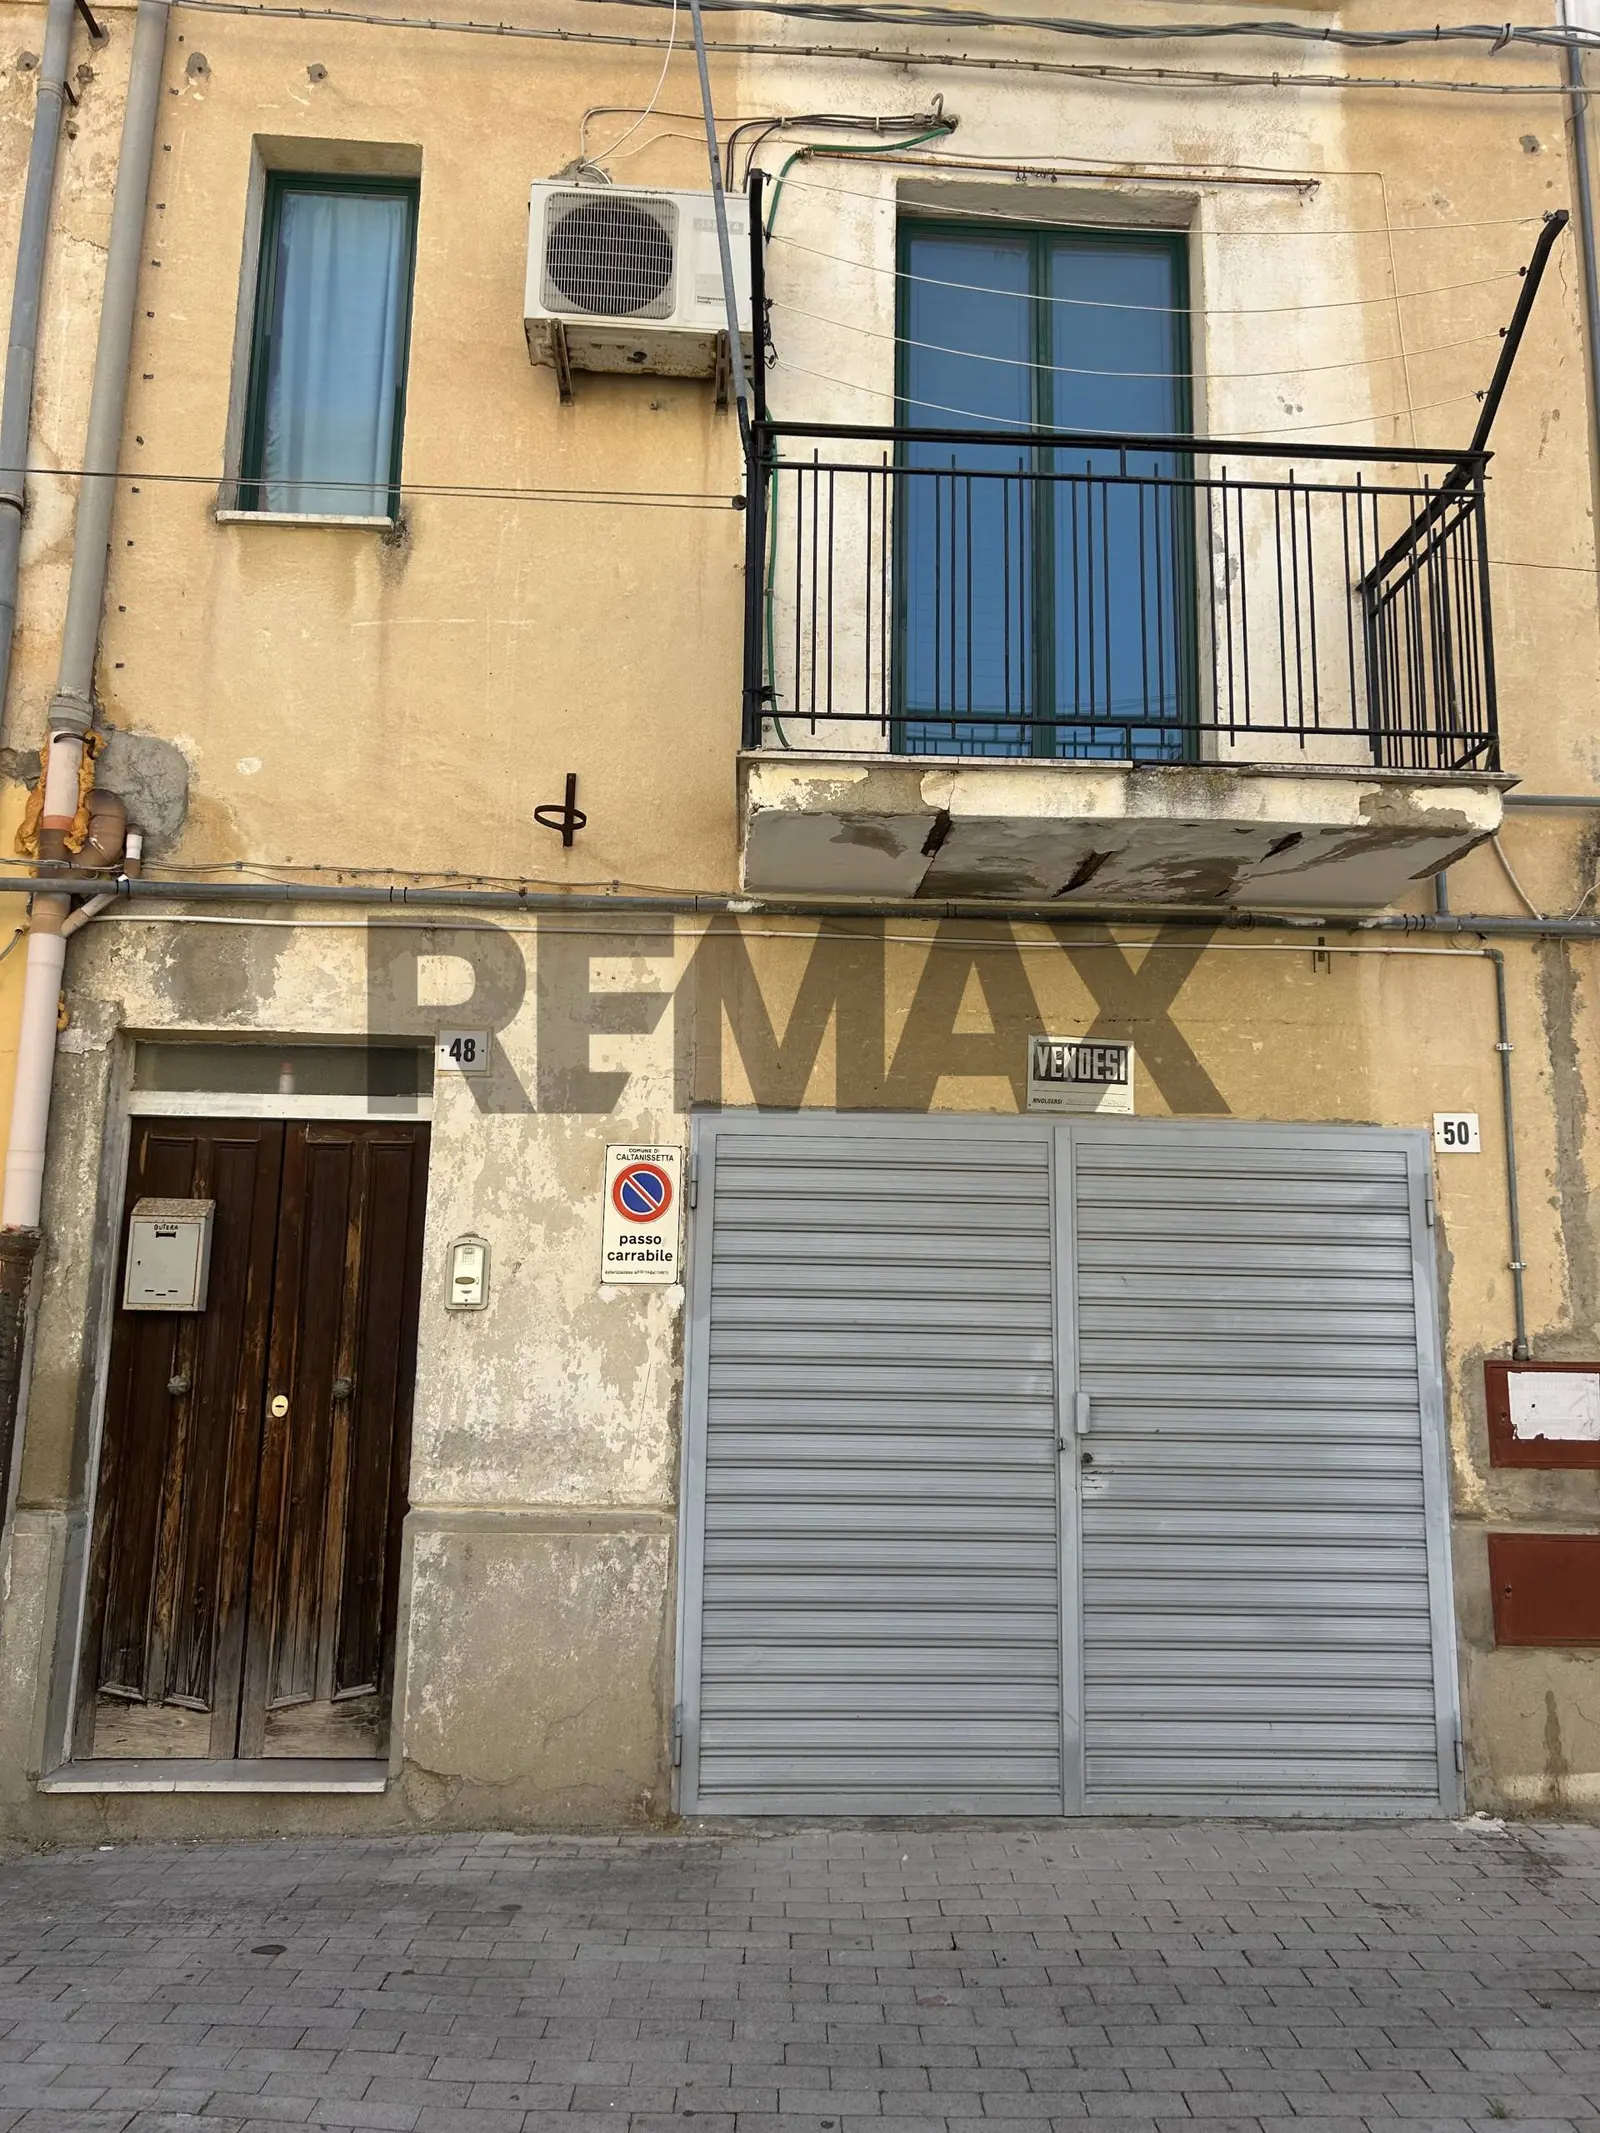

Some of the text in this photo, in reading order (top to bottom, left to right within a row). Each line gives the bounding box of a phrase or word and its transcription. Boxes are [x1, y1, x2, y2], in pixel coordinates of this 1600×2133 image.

[449, 1038, 476, 1062] 48
[1036, 1045, 1126, 1081] VENDESI
[1443, 1121, 1470, 1145] 50
[615, 1153, 675, 1162] CALTANISSETTA
[619, 1235, 662, 1246] passo
[607, 1249, 673, 1262] carrabile
